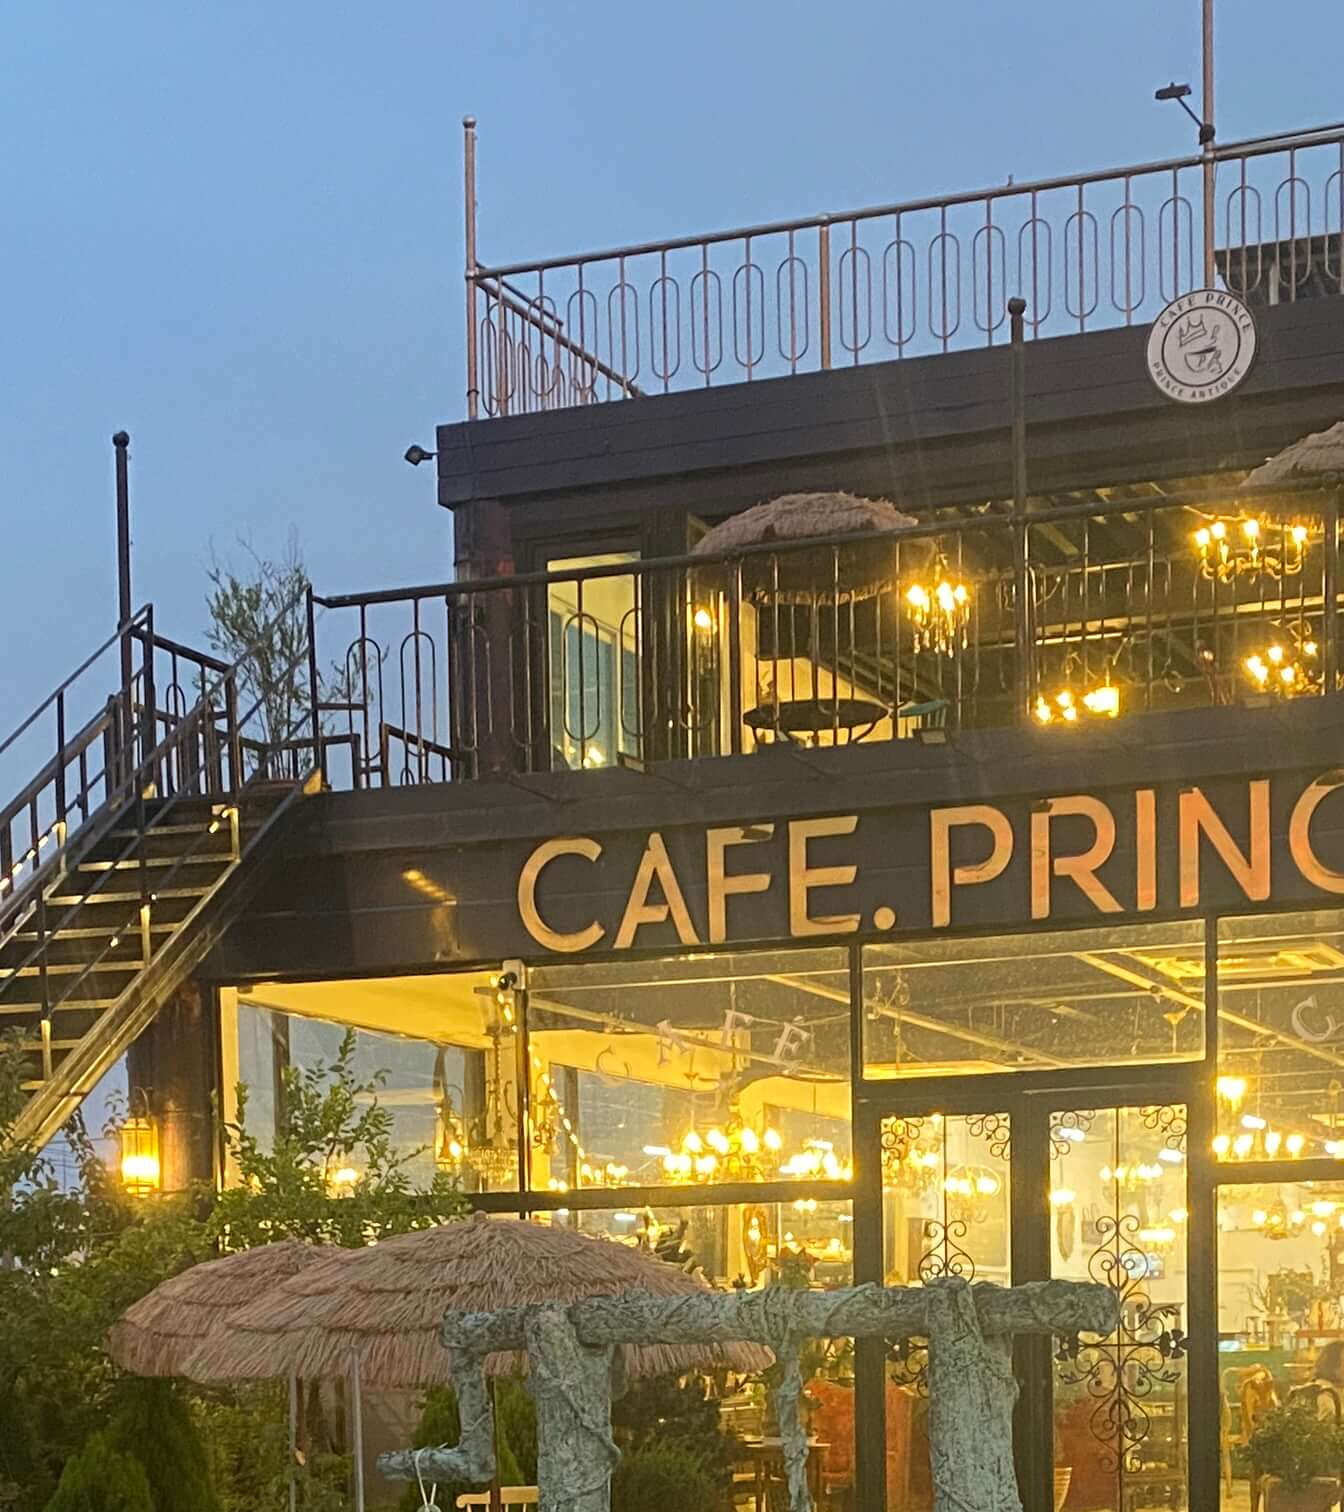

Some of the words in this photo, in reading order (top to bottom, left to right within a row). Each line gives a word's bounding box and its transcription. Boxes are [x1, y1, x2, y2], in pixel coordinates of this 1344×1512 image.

[1160, 296, 1197, 328] CAFE
[1206, 292, 1253, 334] PRINCE
[1152, 361, 1183, 397] PRINCE
[1191, 367, 1241, 399] ANTIQUE
